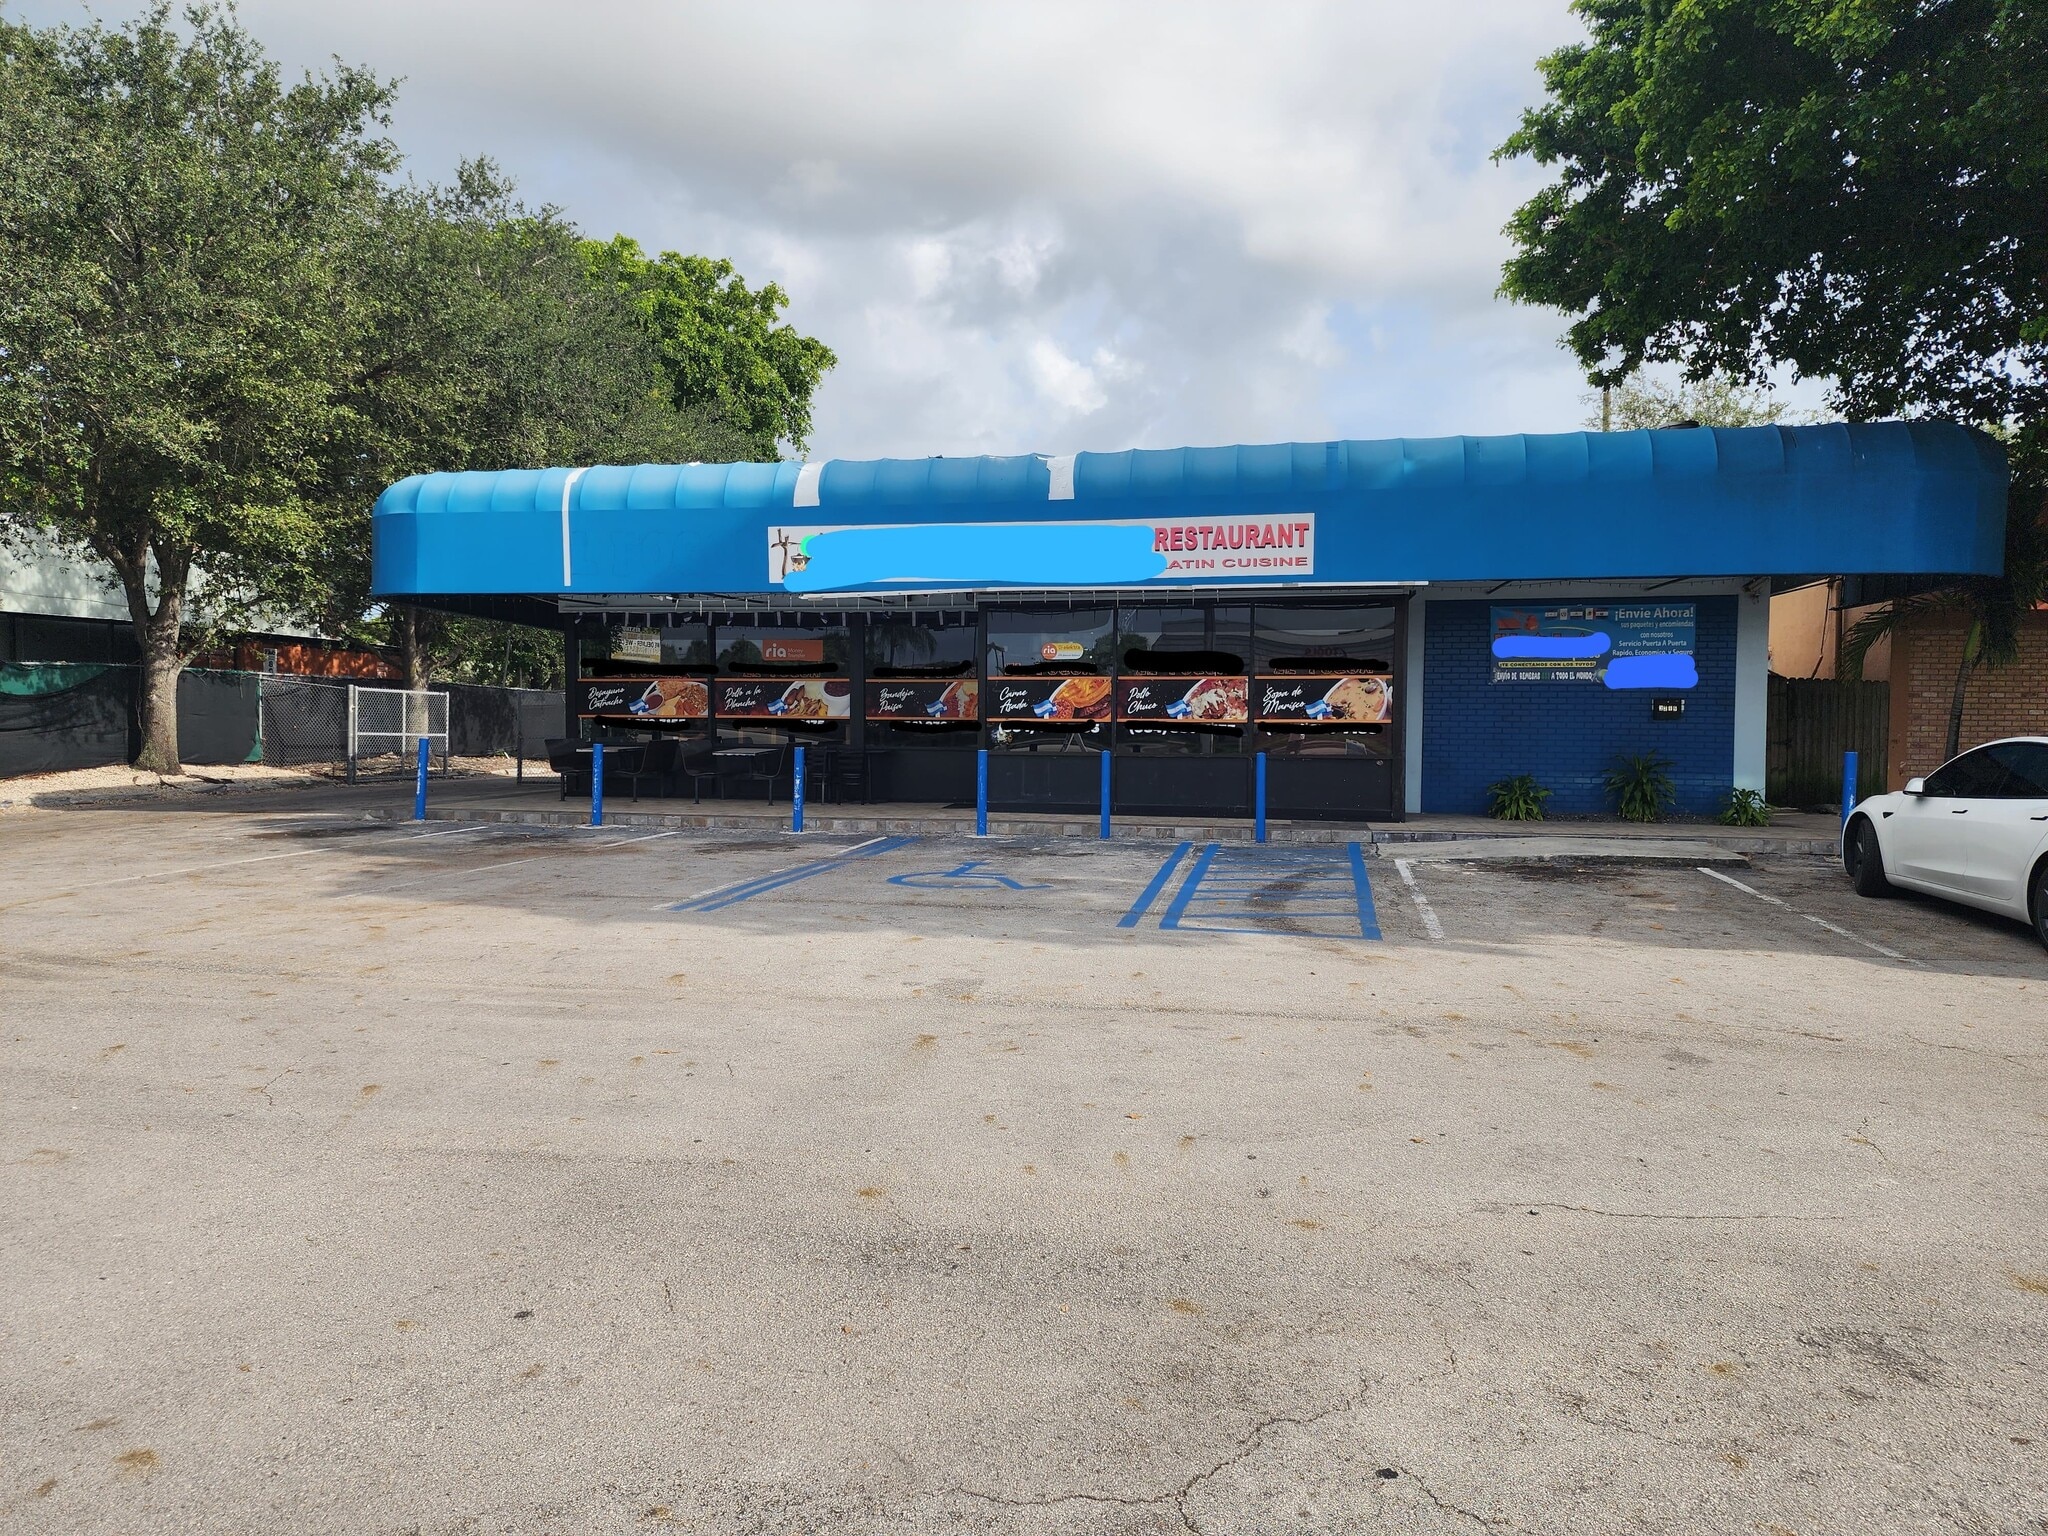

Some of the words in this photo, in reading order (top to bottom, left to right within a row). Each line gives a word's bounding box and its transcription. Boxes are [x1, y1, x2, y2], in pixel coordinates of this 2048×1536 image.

[1154, 523, 1309, 551] RESTAURANT
[1166, 559, 1215, 569] ATIN
[1222, 557, 1308, 568] CUISINE
[1615, 608, 1651, 621] ¡Envie
[1653, 607, 1694, 618] Ahora!
[1629, 621, 1654, 629] paquetes
[765, 643, 787, 658] ria
[1043, 645, 1056, 654] ria
[1511, 671, 1518, 680] DE
[1550, 672, 1556, 680] A
[1556, 671, 1569, 680] TODO
[1569, 671, 1575, 680] EL
[588, 687, 625, 700] Desayuno
[724, 687, 743, 700] Pollo
[753, 685, 762, 696] la
[879, 687, 915, 702] Bandeja
[1000, 687, 1028, 701] Carne
[1127, 686, 1151, 702] Pollo
[1262, 686, 1289, 702] Sopa
[1291, 685, 1303, 697] de
[588, 697, 624, 710] Catracho
[724, 699, 757, 711] Plancha
[878, 700, 903, 713] Paisa
[1000, 699, 1028, 714] Asada
[1127, 701, 1158, 714] Chuco
[1262, 700, 1306, 715] Marisco
